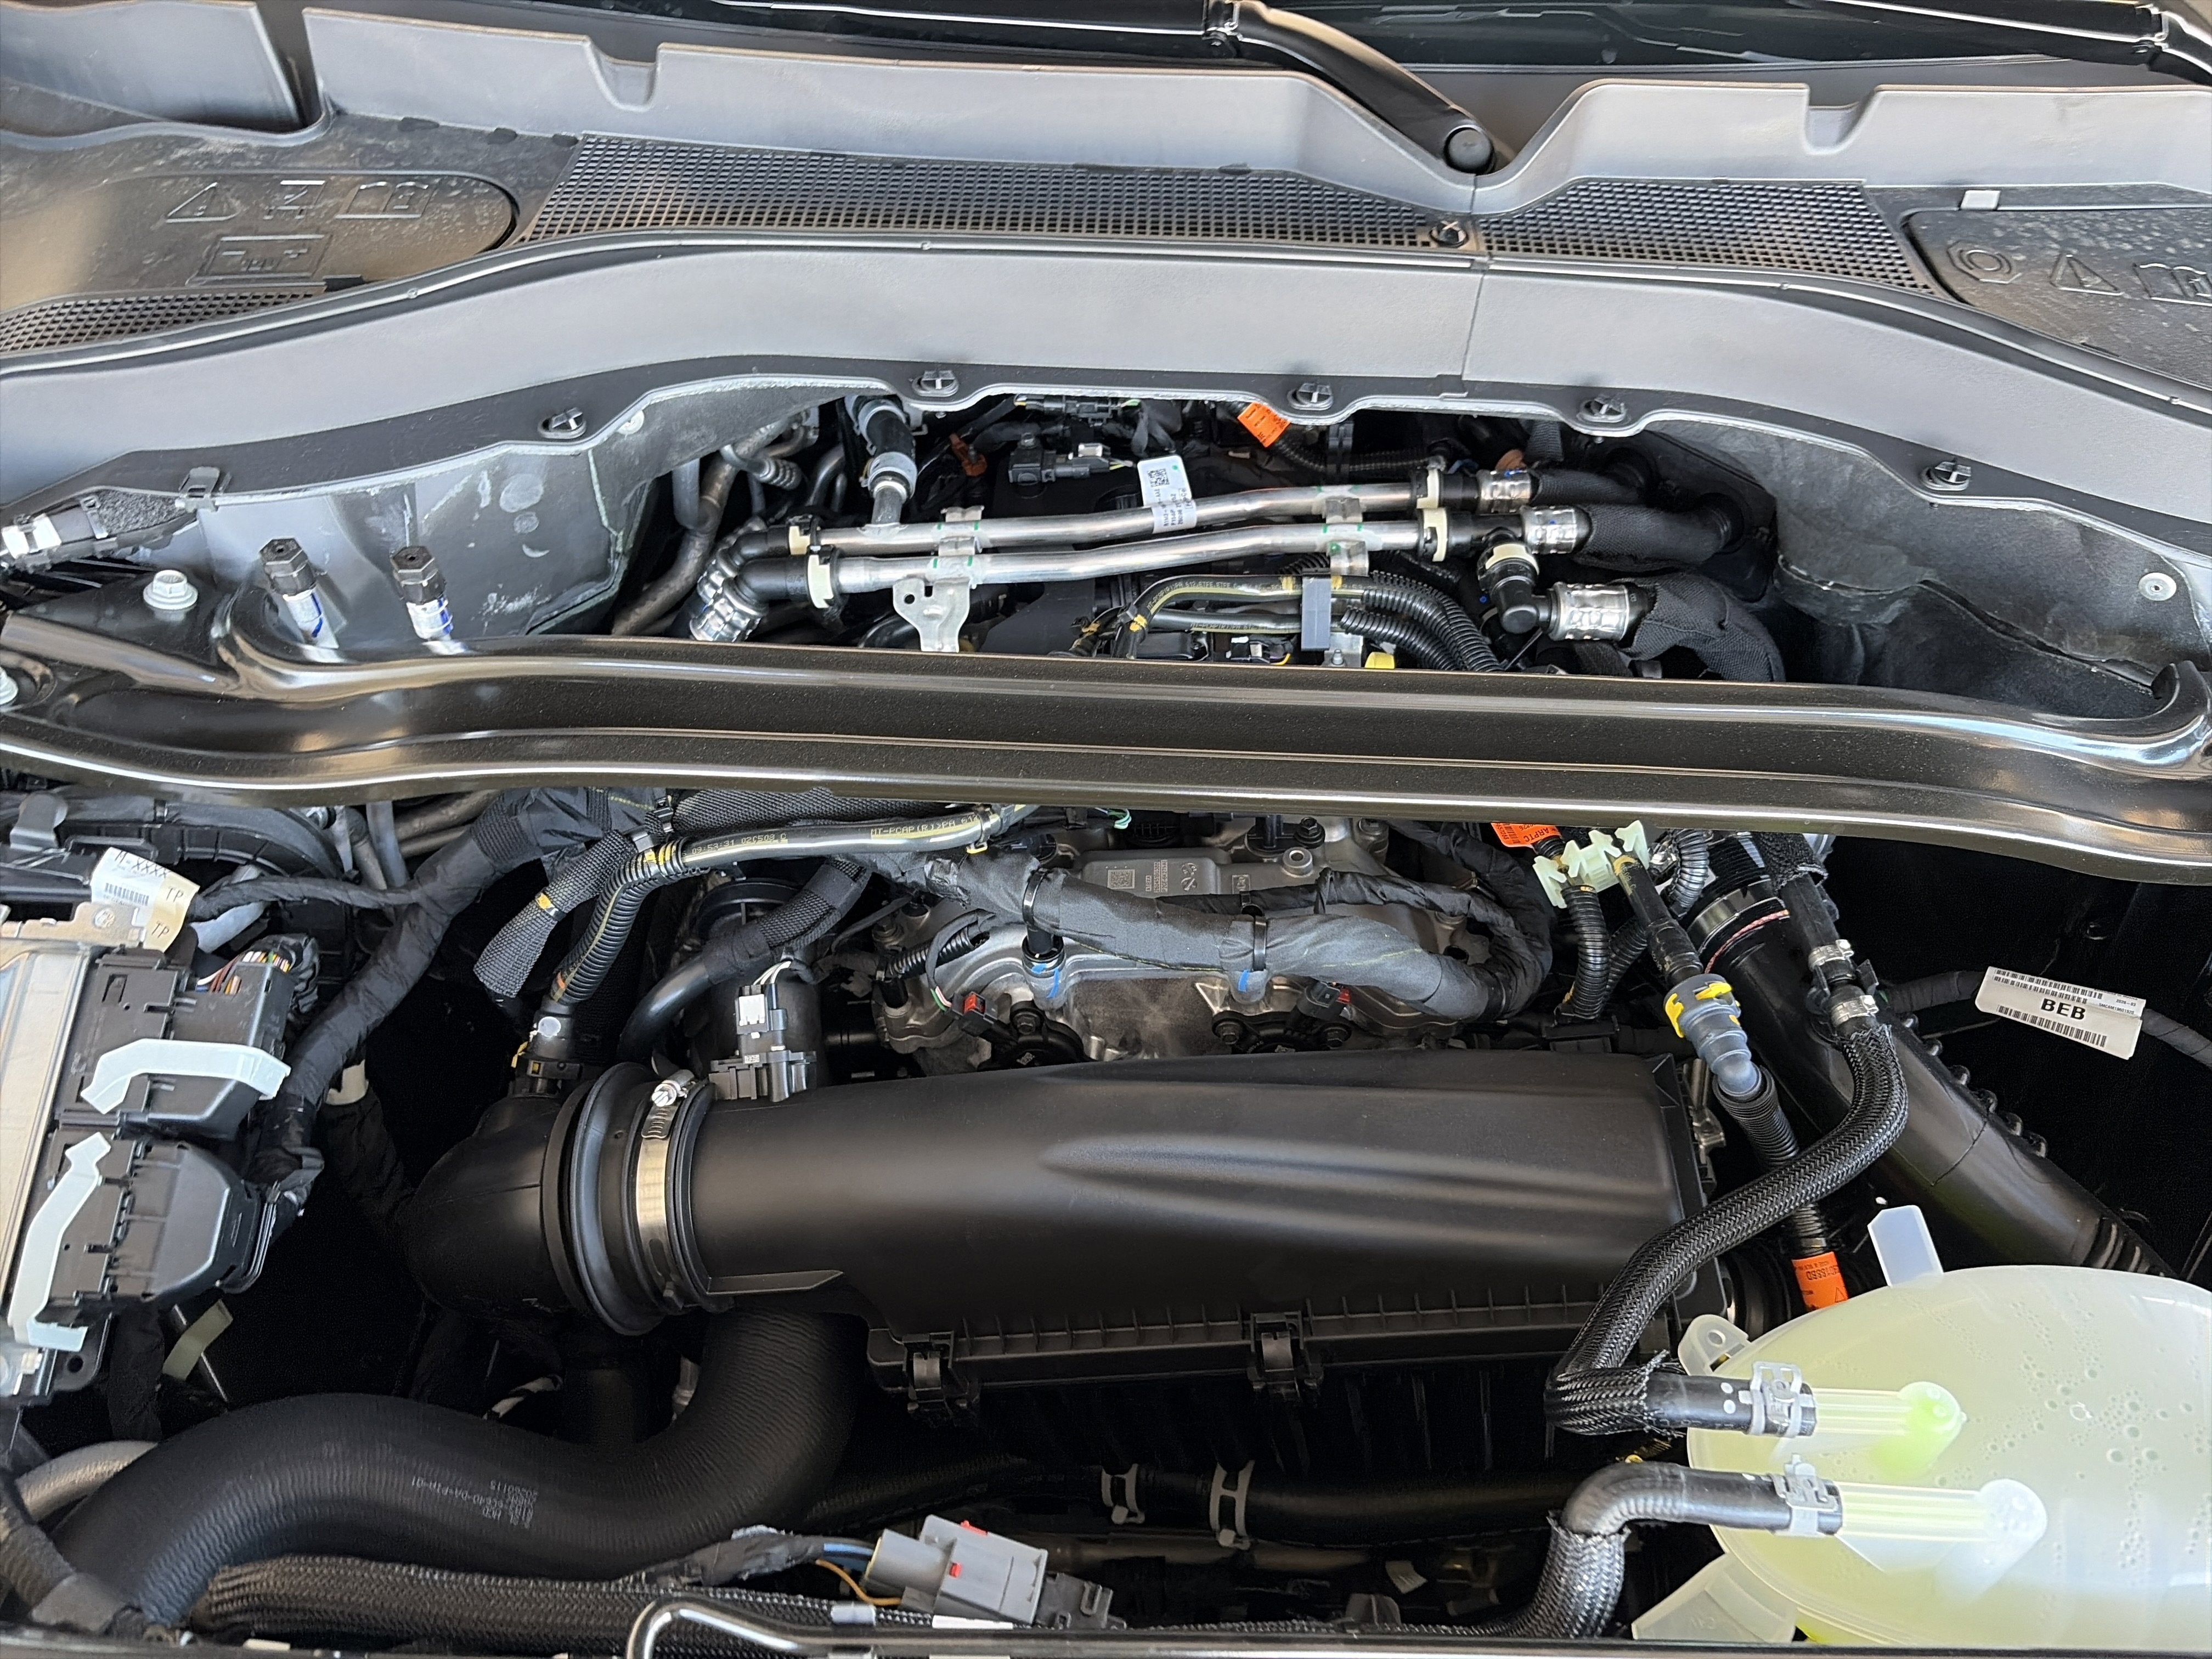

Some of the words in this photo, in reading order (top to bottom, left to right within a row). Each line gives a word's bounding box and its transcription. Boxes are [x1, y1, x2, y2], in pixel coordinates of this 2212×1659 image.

[692, 839, 735, 855] 09:53:31
[166, 887, 184, 902] TP
[151, 921, 170, 938] TP
[2040, 997, 2086, 1020] BEB
